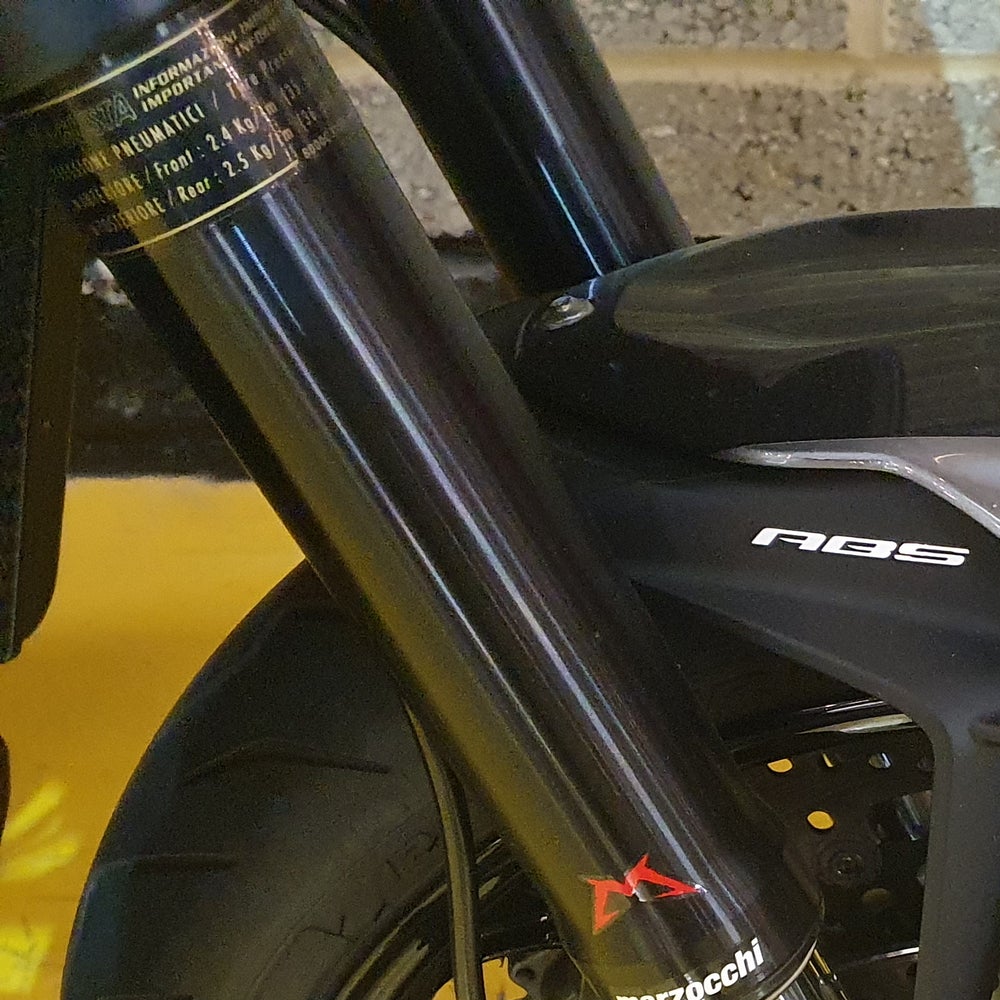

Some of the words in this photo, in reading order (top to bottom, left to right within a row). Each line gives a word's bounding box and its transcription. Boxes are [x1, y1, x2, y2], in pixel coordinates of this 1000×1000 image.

[110, 102, 206, 161] PNEUMATICI
[153, 149, 194, 180] Front
[205, 124, 233, 152] 2.4
[176, 176, 211, 203] Rear
[222, 151, 250, 178] 2.5
[751, 527, 970, 566] ABS
